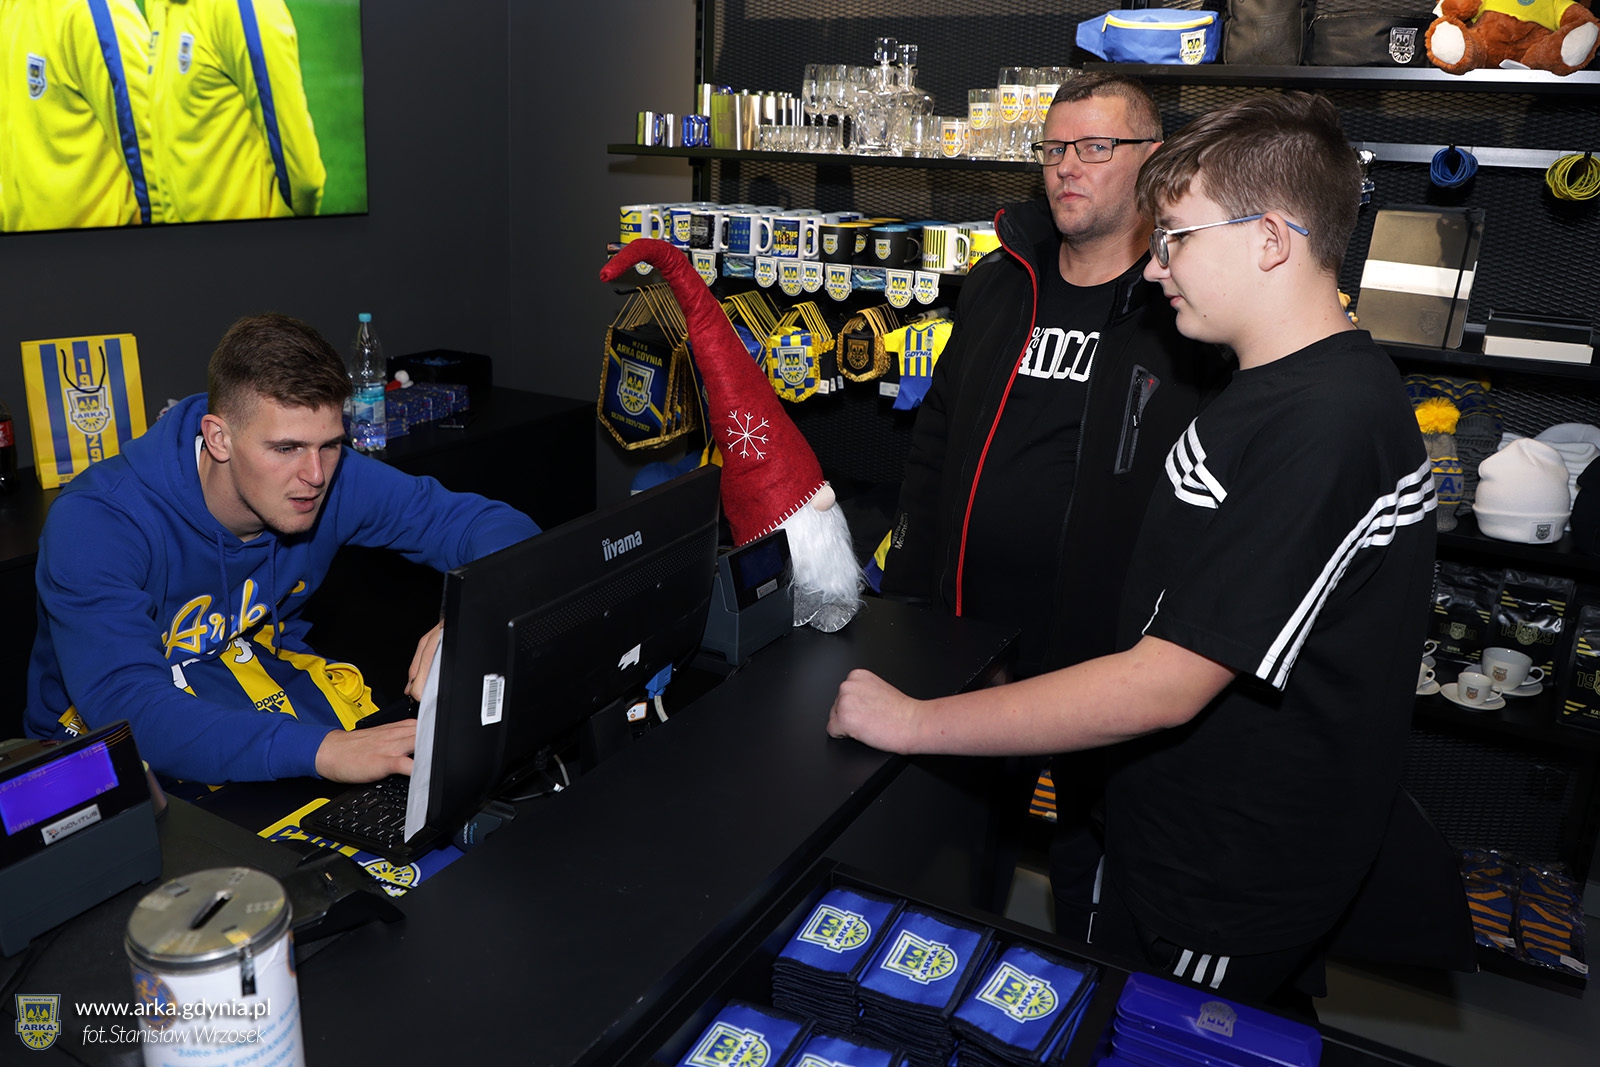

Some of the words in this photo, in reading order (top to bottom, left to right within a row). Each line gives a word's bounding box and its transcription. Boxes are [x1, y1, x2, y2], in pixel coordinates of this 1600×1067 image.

[616, 343, 636, 358] ARKA
[636, 349, 663, 367] GDYNIA
[904, 350, 932, 359] GDYNIA
[622, 388, 645, 401] ARKA
[76, 411, 105, 419] ARKA
[601, 537, 643, 562] iiyama
[160, 578, 273, 661] Ark
[60, 810, 98, 833] NOVITUS
[835, 919, 855, 945] ARKA
[920, 949, 940, 977] ARKA
[1017, 985, 1041, 1014] ARKA
